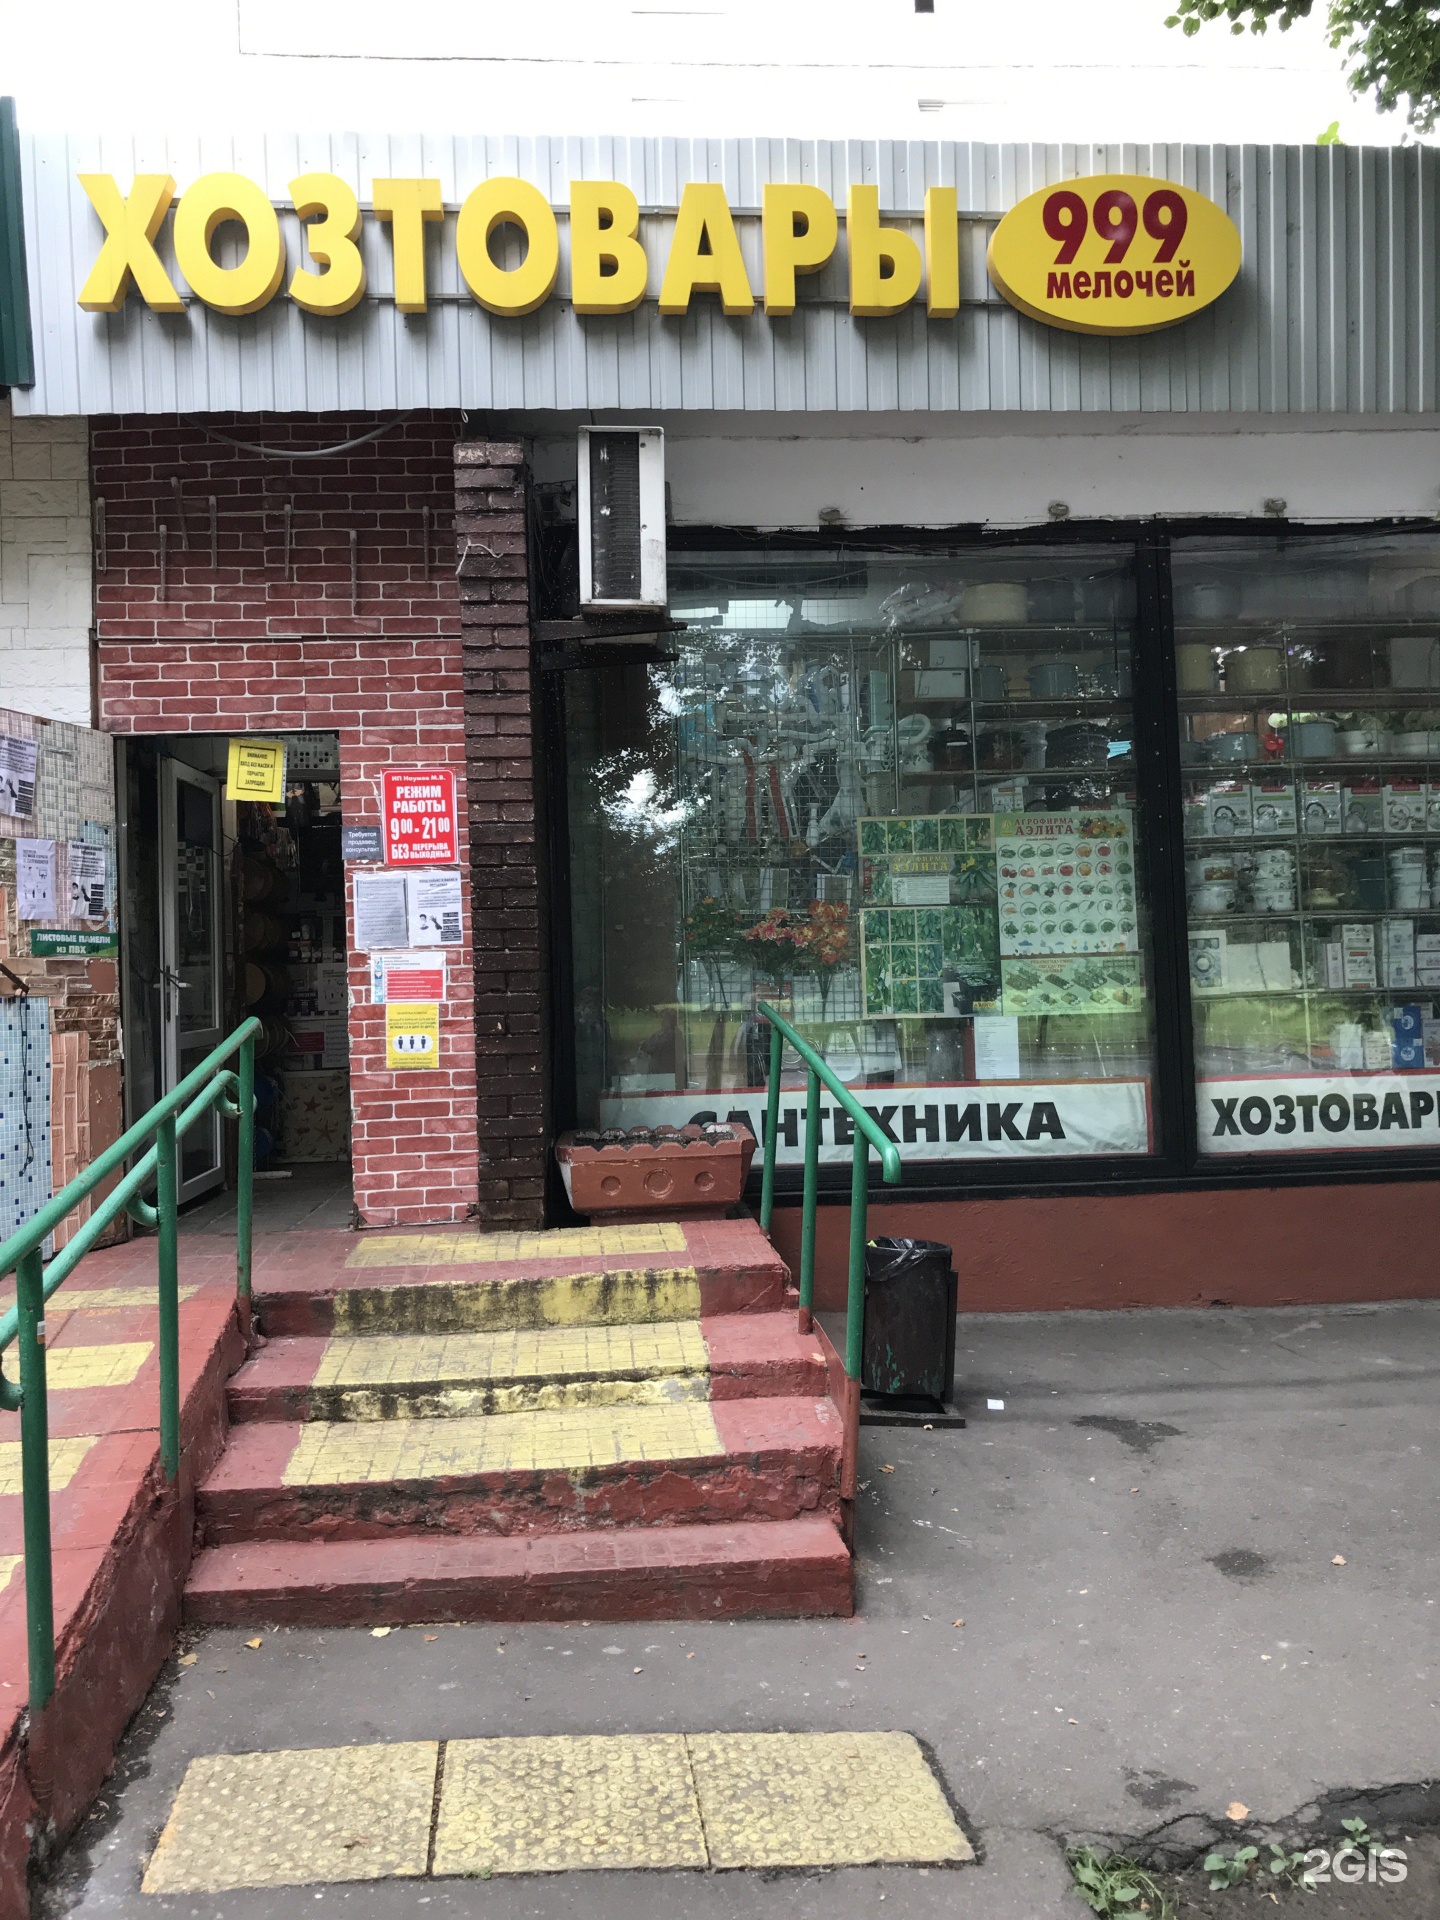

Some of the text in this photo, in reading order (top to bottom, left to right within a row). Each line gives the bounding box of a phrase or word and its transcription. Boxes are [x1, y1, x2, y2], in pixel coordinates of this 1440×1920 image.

[1042, 189, 1188, 265] 999
[76, 172, 961, 318] ХОЗТОВАРЫ
[1046, 259, 1195, 299] мелочей
[396, 785, 442, 799] РЕЖИМ
[393, 799, 446, 814] РАБОТЫ
[1014, 818, 1074, 826] АГРОФИРМА
[1014, 825, 1075, 836] АЭЛИТА
[391, 843, 449, 860] БЕЗ ПЕРЕРЫВА
[410, 850, 452, 859] ВЫХОДНЫХ
[36, 933, 111, 944] ЛИСТОВЫЕ ПАНЕЛИ
[68, 945, 87, 954] ПВХ
[1210, 1091, 1440, 1137] ХОЗТОВАР
